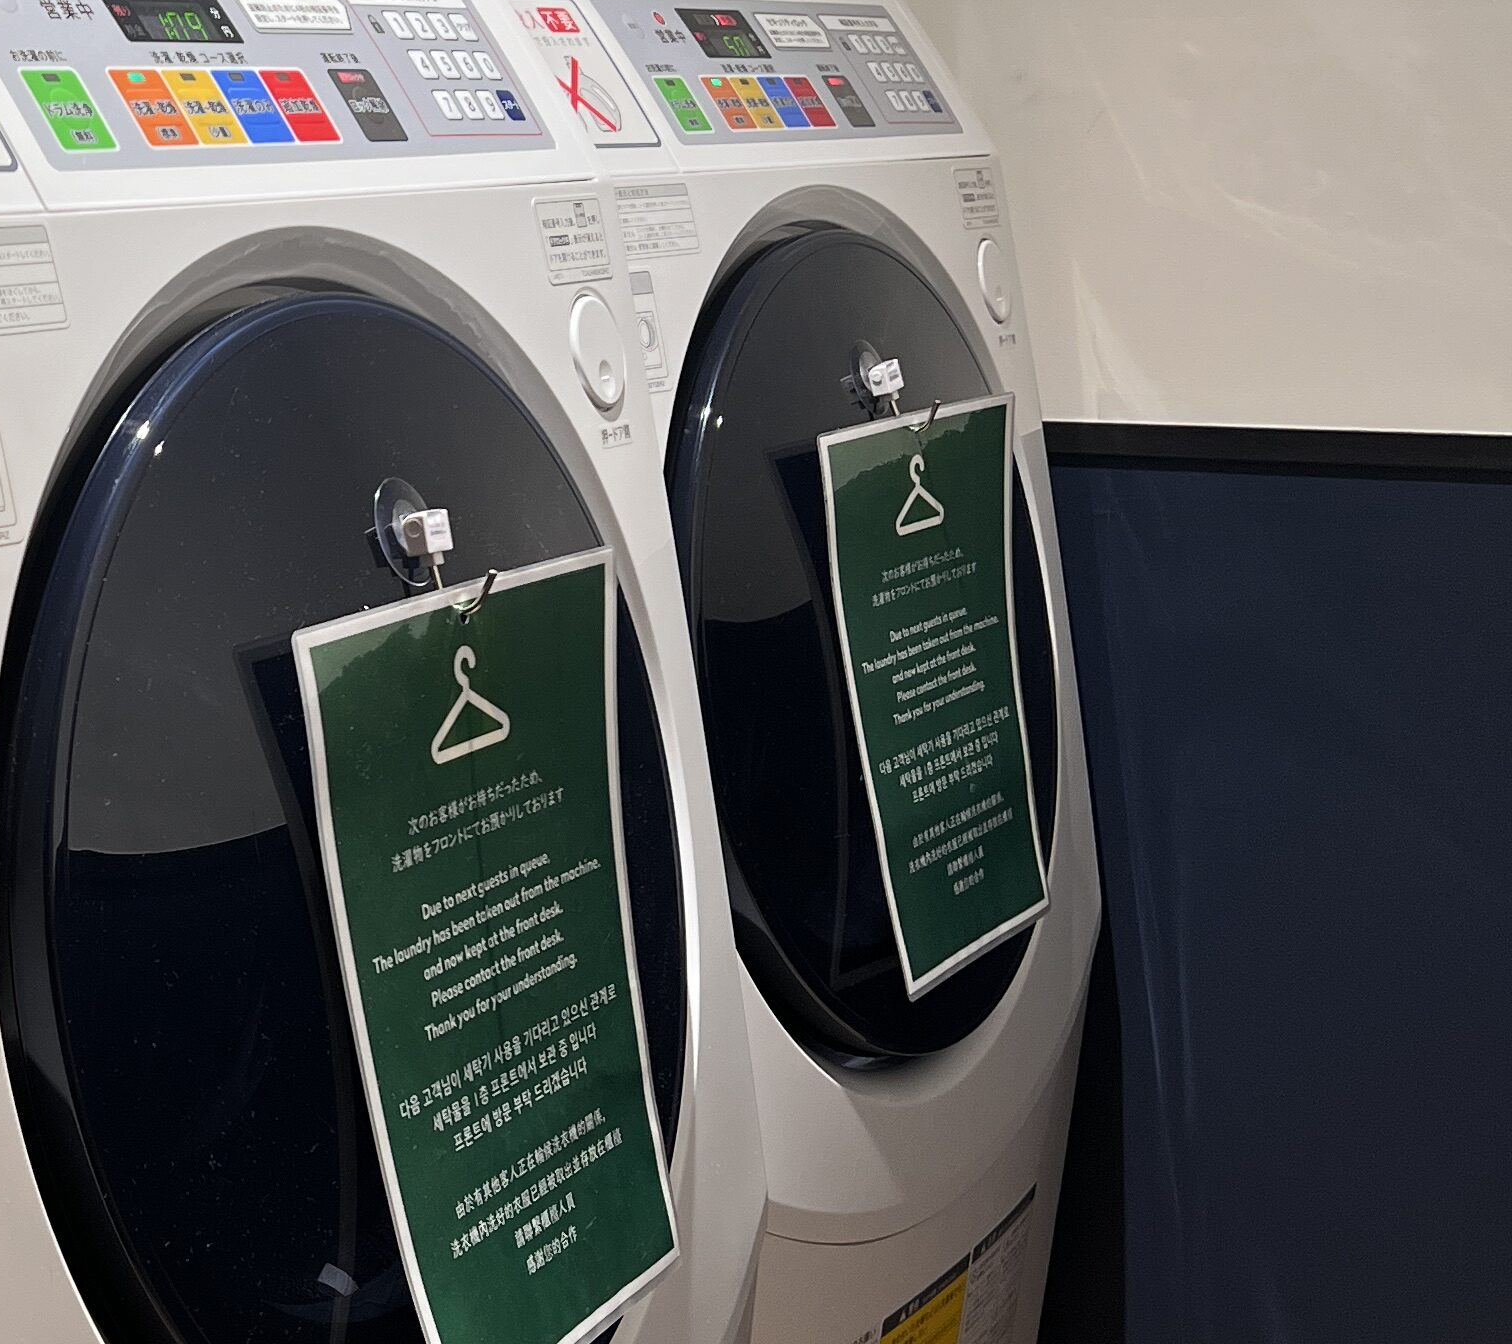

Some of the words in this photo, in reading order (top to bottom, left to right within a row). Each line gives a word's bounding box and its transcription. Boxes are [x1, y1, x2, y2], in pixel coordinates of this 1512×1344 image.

[372, 953, 394, 975] The
[393, 935, 433, 965] laundry
[433, 927, 451, 947] has
[451, 914, 475, 937] been
[475, 901, 504, 926] taken
[504, 895, 521, 913] out
[521, 883, 544, 904] from
[543, 874, 560, 892] the
[560, 856, 602, 886] machine.
[421, 901, 443, 921] Due
[443, 895, 455, 911] to
[455, 883, 478, 906] next
[477, 871, 509, 899] guests
[509, 865, 520, 880] in
[519, 852, 551, 877] queue.
[423, 960, 444, 982] and
[444, 952, 464, 971] now
[465, 939, 487, 963] kept
[487, 932, 499, 947] at
[499, 923, 516, 941] the
[515, 911, 539, 936] front
[539, 899, 564, 923] desk.
[430, 981, 464, 1009] Please
[464, 963, 501, 989] contact
[500, 953, 516, 971] the
[516, 940, 540, 965] front
[540, 928, 565, 952] desk.
[423, 1016, 458, 1043] Thank
[457, 1006, 476, 1030] you
[475, 996, 491, 1014] for
[491, 986, 513, 1012] your
[513, 951, 579, 997] understanding.
[399, 1093, 421, 1120] 다음
[421, 1069, 463, 1107] 고객님이
[463, 1051, 493, 1083] 세탁기
[493, 1033, 523, 1064] 사용을
[523, 1014, 561, 1048] 기다리고
[561, 999, 589, 1027] 있으신
[589, 982, 618, 1009] 관계로
[432, 1094, 472, 1133] 세탁물을
[473, 1084, 489, 1109] 1층
[490, 1058, 538, 1098] 프론트에서
[538, 1045, 558, 1070] 보관
[558, 1038, 569, 1058] 중
[568, 1021, 598, 1053] 입니다
[453, 1112, 493, 1152] 프론트에
[492, 1102, 512, 1131] 방문
[513, 1088, 533, 1116] 부탁
[534, 1055, 588, 1103] 드리겠습니다
